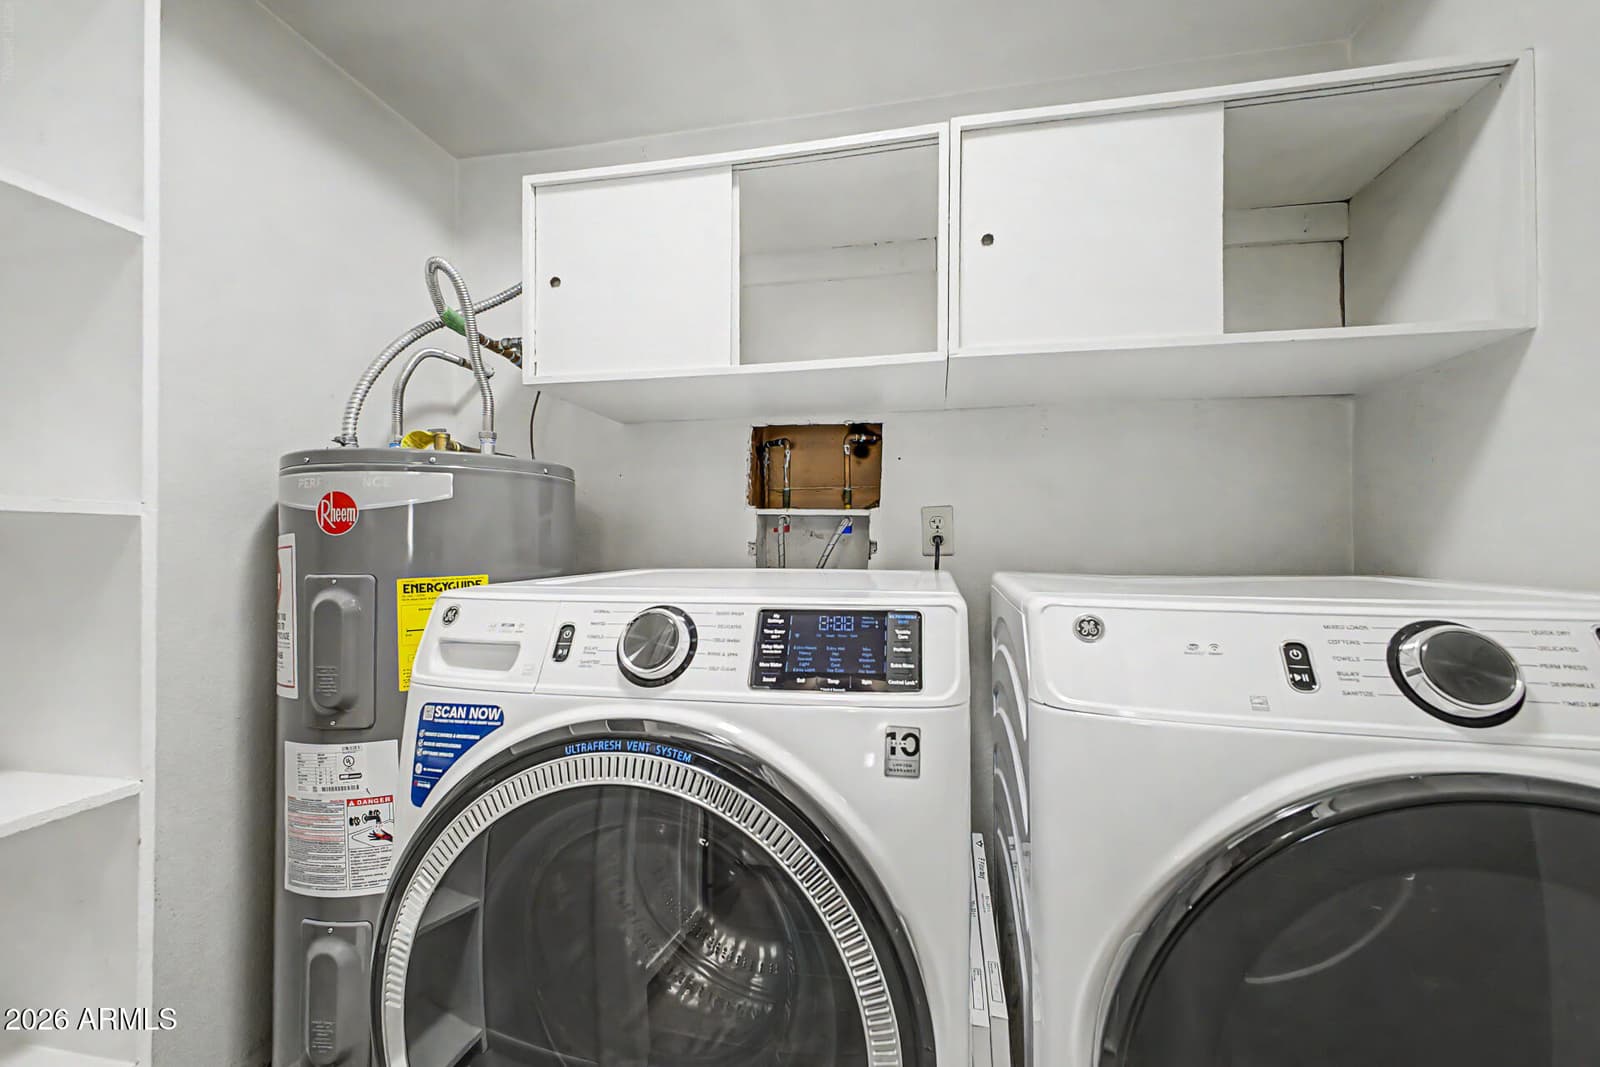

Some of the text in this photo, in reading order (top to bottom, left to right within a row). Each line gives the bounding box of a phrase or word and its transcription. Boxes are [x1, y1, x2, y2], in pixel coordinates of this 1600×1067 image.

[320, 492, 356, 529] Rheem
[435, 706, 502, 720] SCAN NOW
[564, 740, 693, 763] ULTRAFRESH VENT SYSTEM
[886, 732, 920, 757] 10
[357, 796, 391, 806] DANGER
